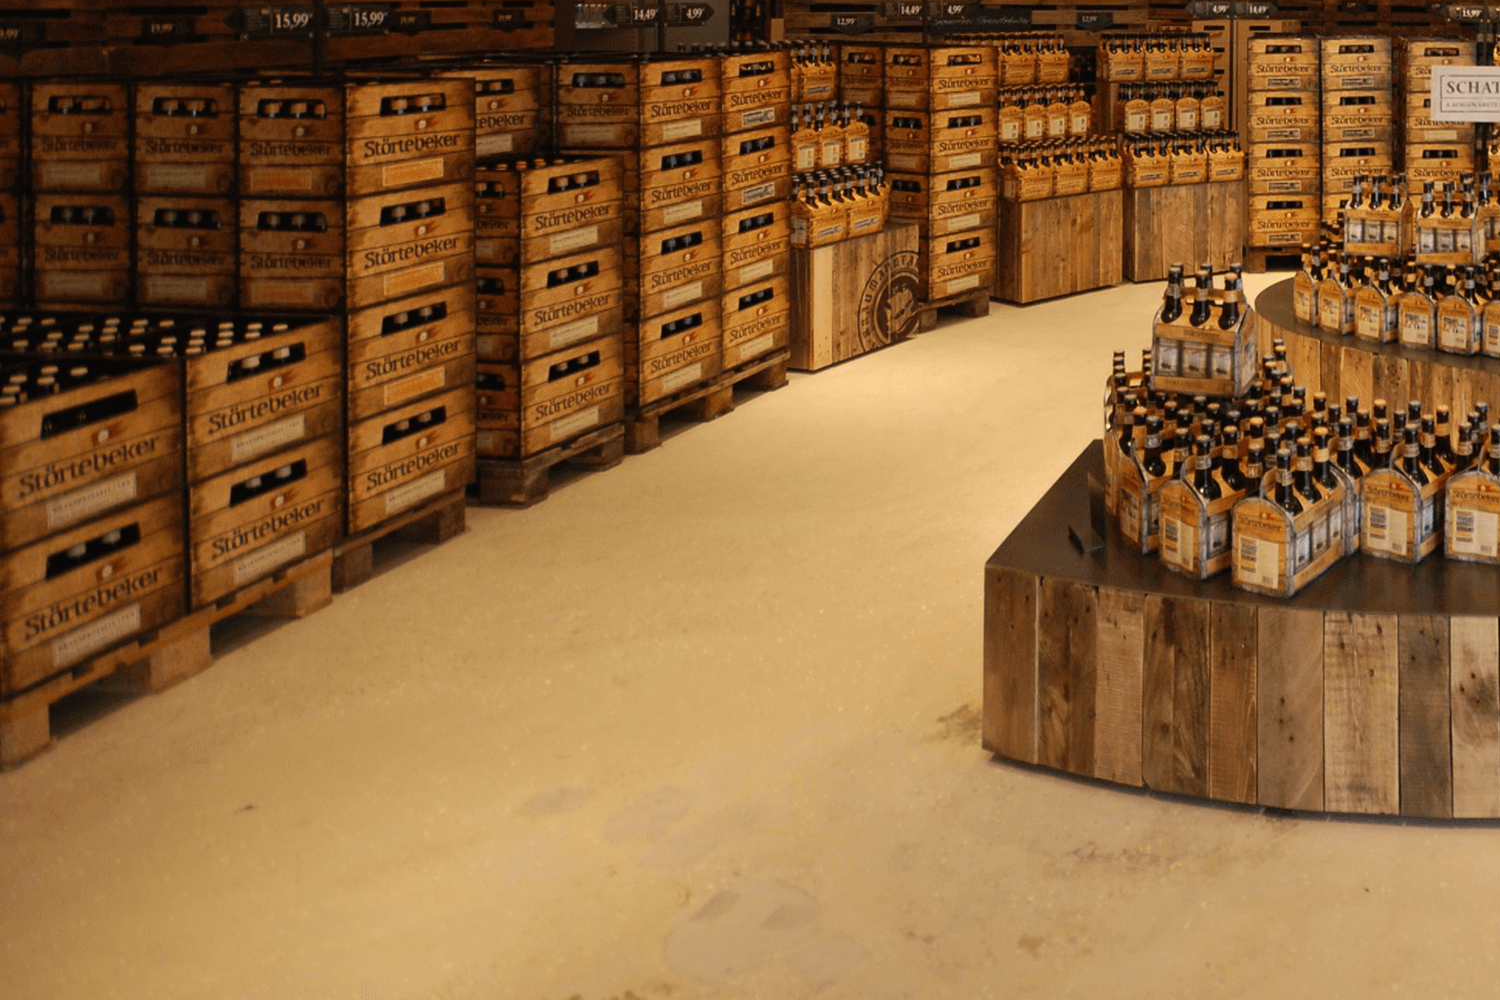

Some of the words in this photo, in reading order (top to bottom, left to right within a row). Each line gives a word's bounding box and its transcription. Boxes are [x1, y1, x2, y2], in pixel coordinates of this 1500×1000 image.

[1256, 64, 1310, 74] Störtebeker
[938, 77, 990, 90] Störtebeker
[651, 100, 712, 118] Störtebeker
[730, 89, 783, 107] Störtebeker
[566, 105, 630, 118] Störtebeker
[1256, 116, 1310, 126] Störtebeker
[363, 133, 460, 158] Störtebeker
[939, 138, 991, 152] Störtebeker
[731, 163, 783, 186] Störtebeker
[1257, 168, 1311, 178] Störtebeker
[651, 181, 712, 203] Störtebeker
[535, 203, 611, 231] Störtebeker
[938, 199, 989, 216] Störtebeker
[1257, 220, 1311, 229] Störtebeker
[364, 236, 460, 270] Störtebeker
[730, 240, 782, 265] Störtebeker
[651, 260, 712, 289] Störtebeker
[937, 259, 989, 279] Störtebeker
[534, 293, 612, 327] Störtebeker
[729, 314, 782, 343] Störtebeker
[365, 338, 461, 381] Störtebeker
[651, 342, 712, 374] Störtebeker
[208, 383, 324, 435] Störtebeker
[535, 381, 612, 422] Störtebeker
[19, 434, 162, 498] Störtebeker
[366, 442, 462, 491] Störtebeker
[212, 499, 325, 561] Störtebeker
[25, 566, 162, 642] Störtebeker
